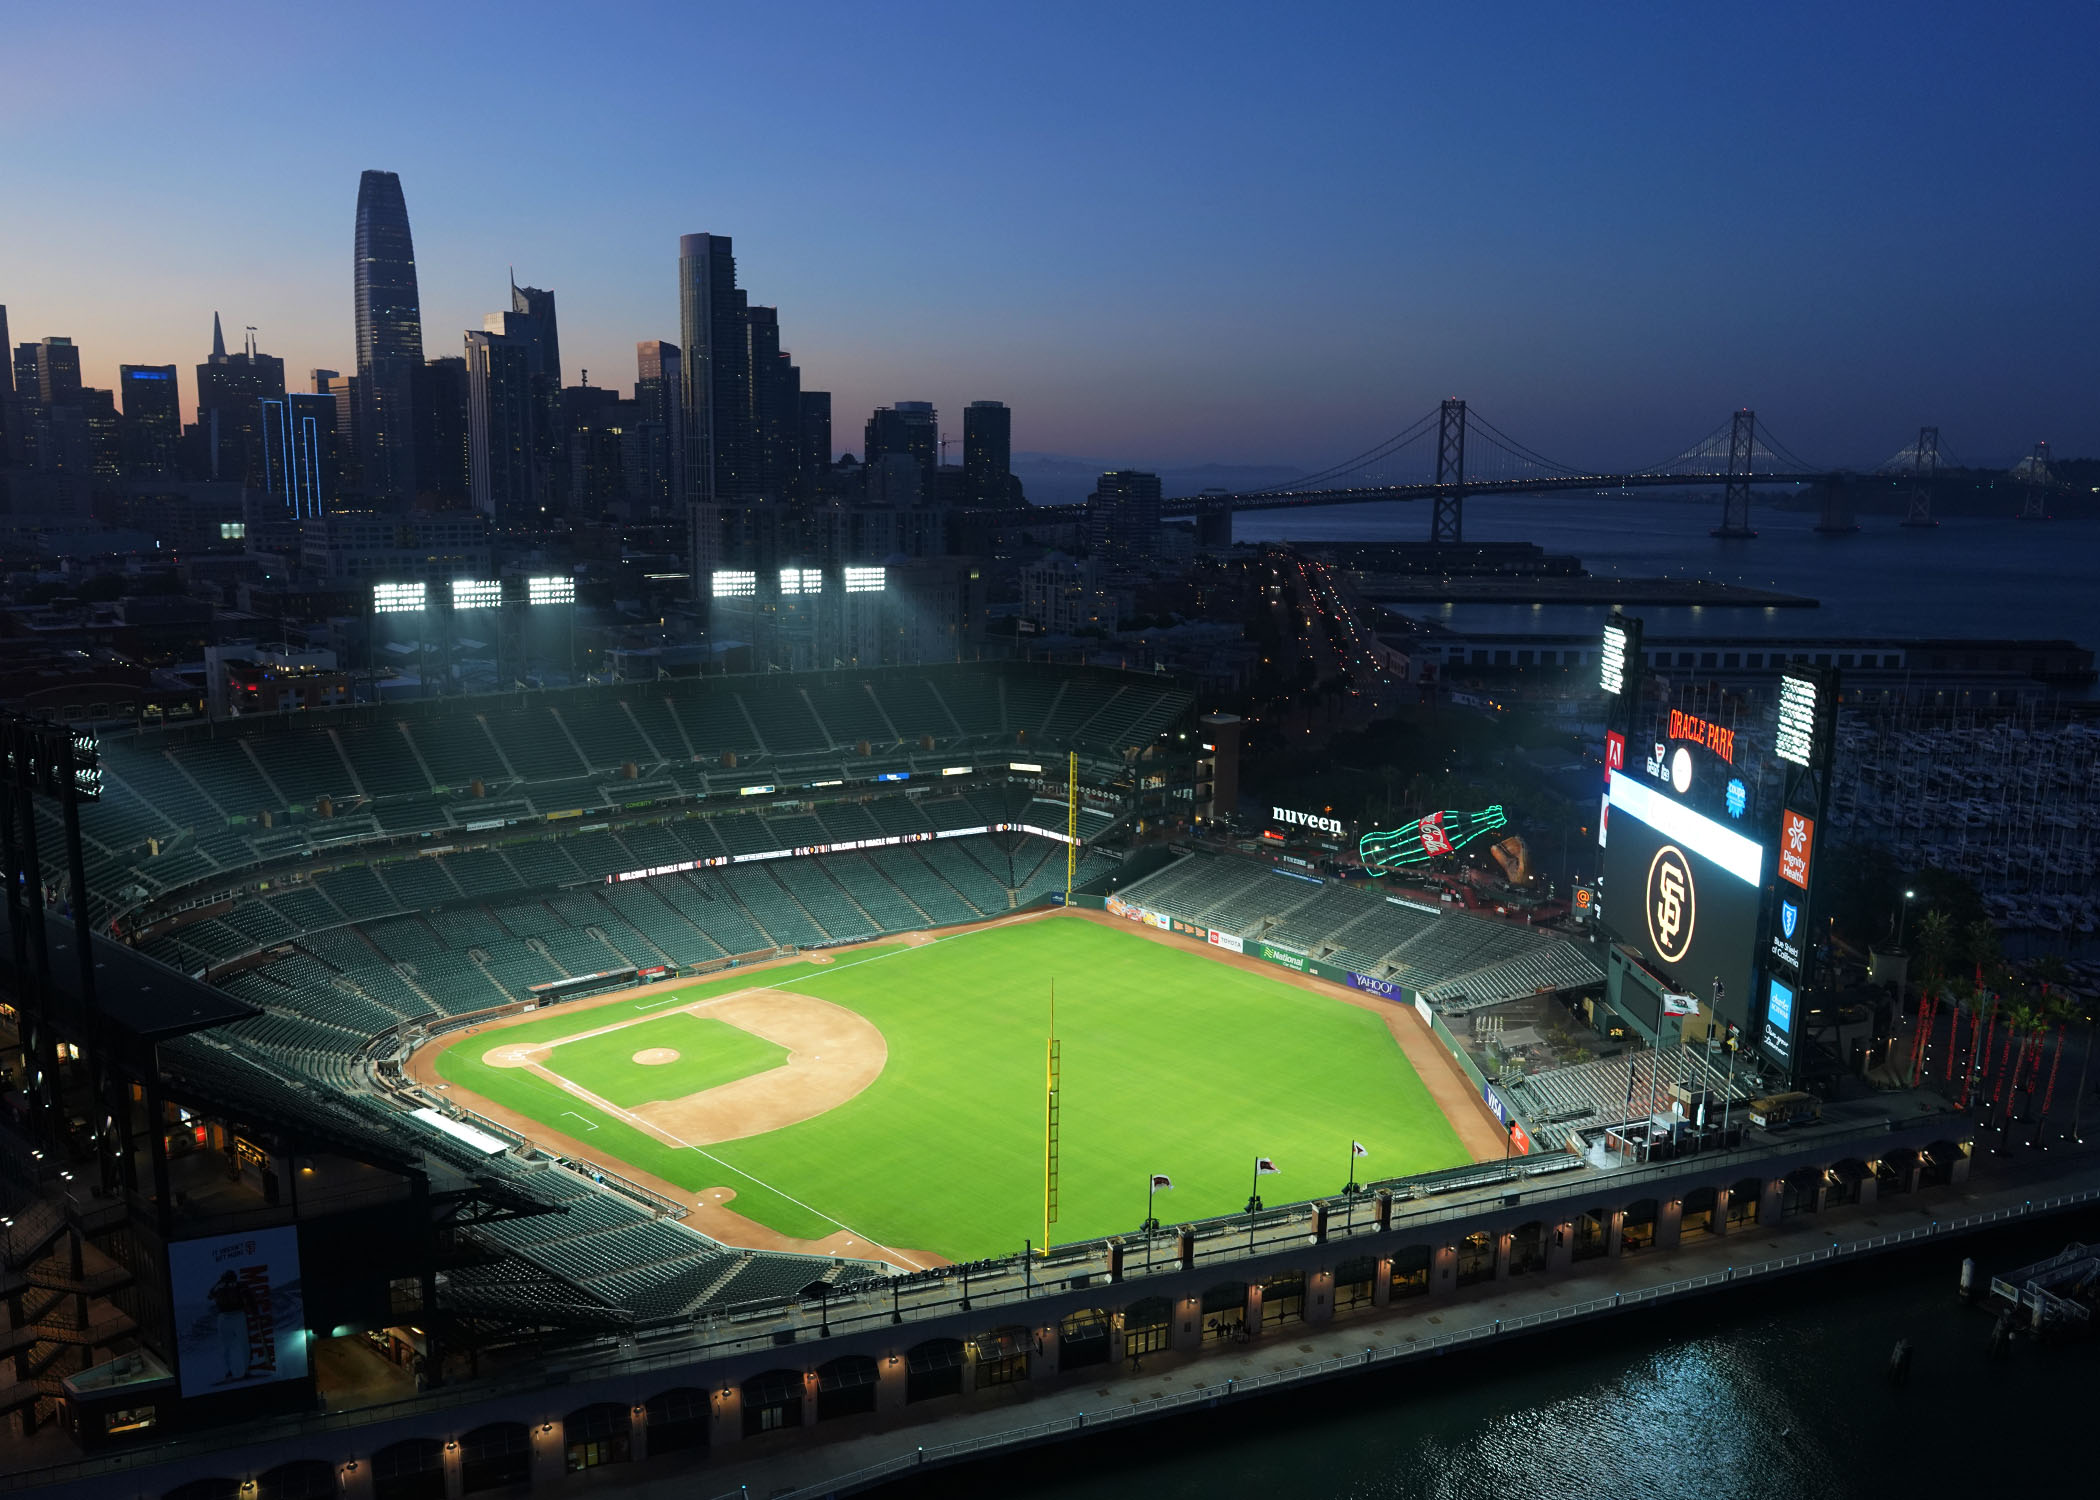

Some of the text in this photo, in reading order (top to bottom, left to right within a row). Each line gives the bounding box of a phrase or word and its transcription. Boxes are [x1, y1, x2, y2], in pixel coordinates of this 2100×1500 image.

[1669, 709, 1735, 766] ORACLE PARK
[1272, 806, 1342, 833] nuveen
[1421, 824, 1449, 853] Cola
[619, 861, 694, 881] WELCOME TO ORACLE PARK
[1783, 849, 1806, 872] Dignity
[1220, 937, 1242, 948] TOYOTA
[1773, 936, 1799, 958] Blue Shield
[1273, 950, 1303, 967] National
[1771, 946, 1799, 968] of California
[1356, 974, 1393, 995] YAHOO!
[1365, 987, 1381, 996] SPORTS
[1487, 1088, 1502, 1121] VISA
